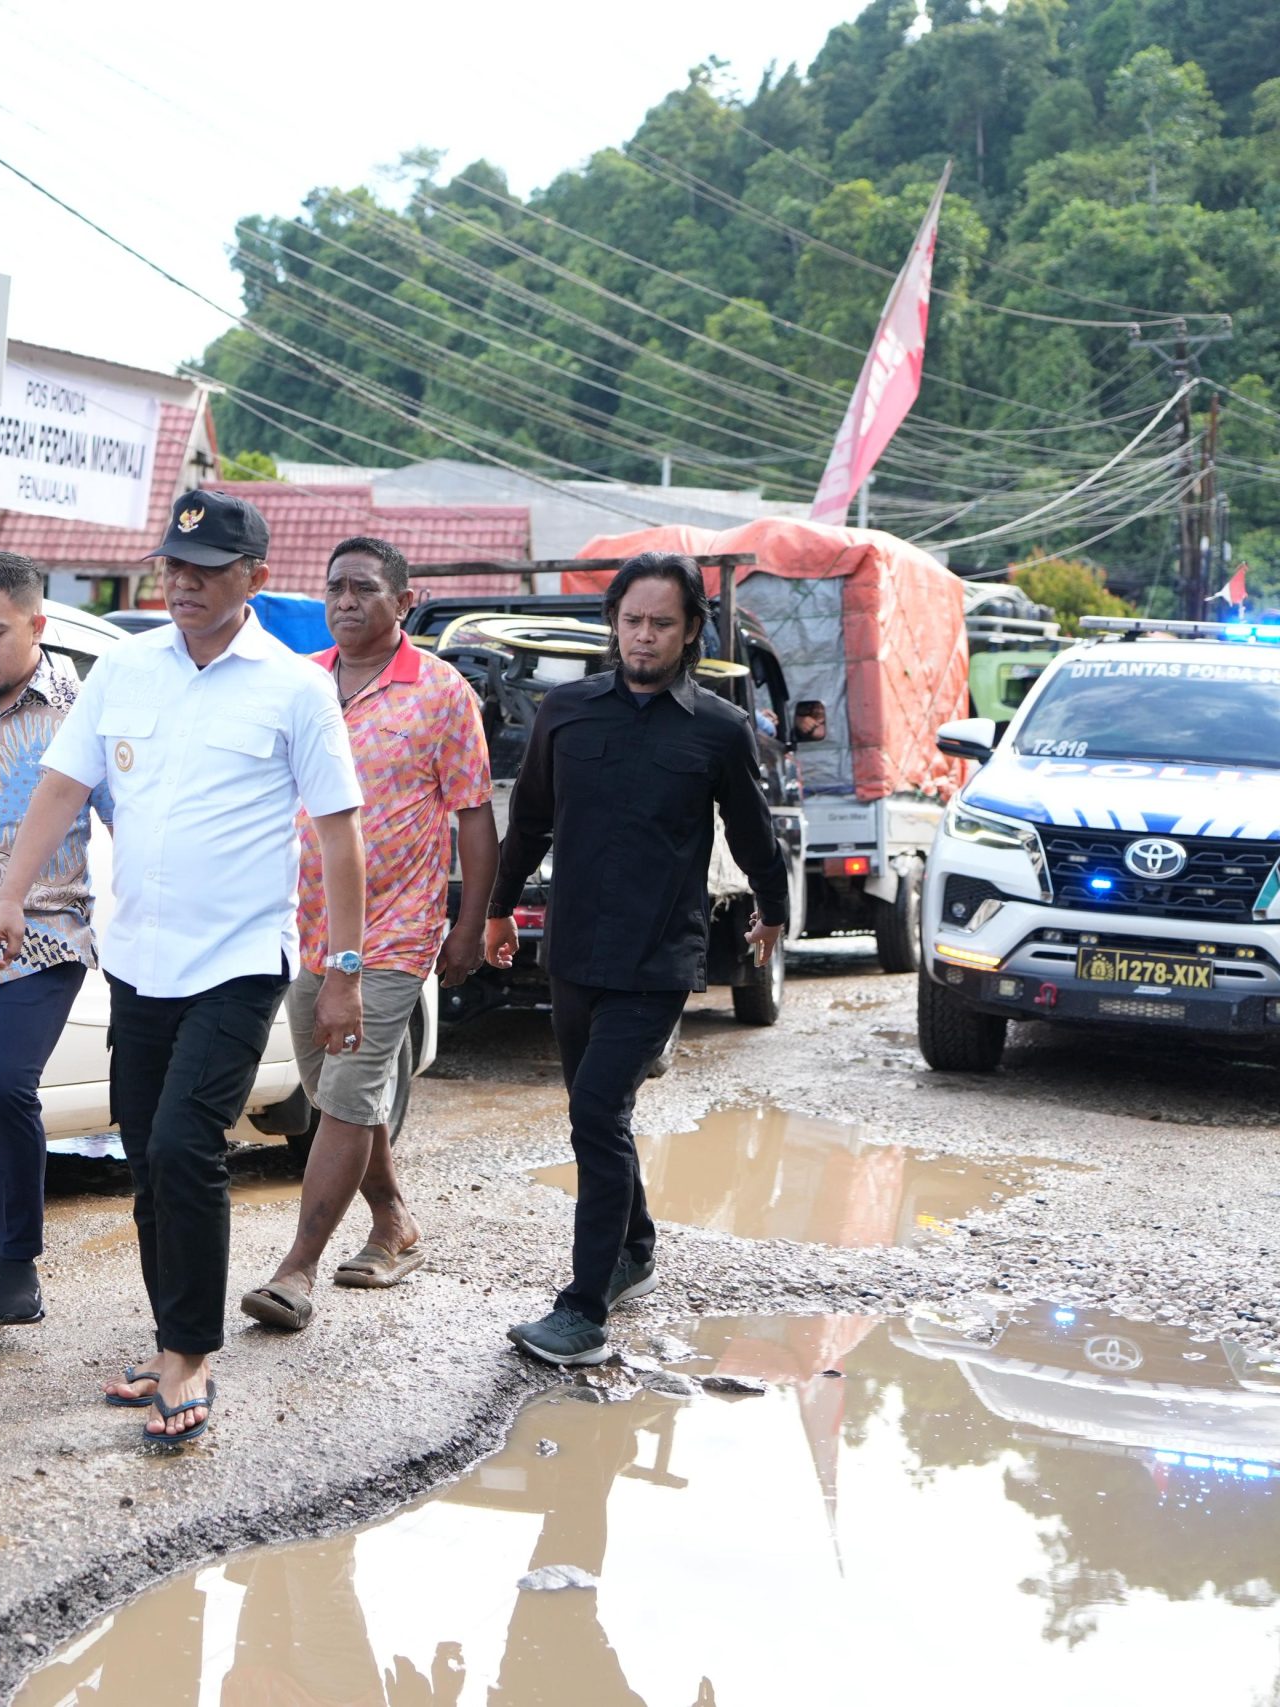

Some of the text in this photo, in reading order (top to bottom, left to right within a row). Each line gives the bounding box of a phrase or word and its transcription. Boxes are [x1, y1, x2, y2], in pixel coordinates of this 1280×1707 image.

[26, 380, 87, 417] POS HONDA
[38, 424, 88, 470] PERDANA
[91, 434, 147, 481] MOROWALI
[18, 474, 78, 507] PENJUALAN
[1071, 662, 1183, 679] DITLANTAS
[1032, 739, 1089, 758] TZ-818
[1120, 959, 1210, 988] 1278-XIX
